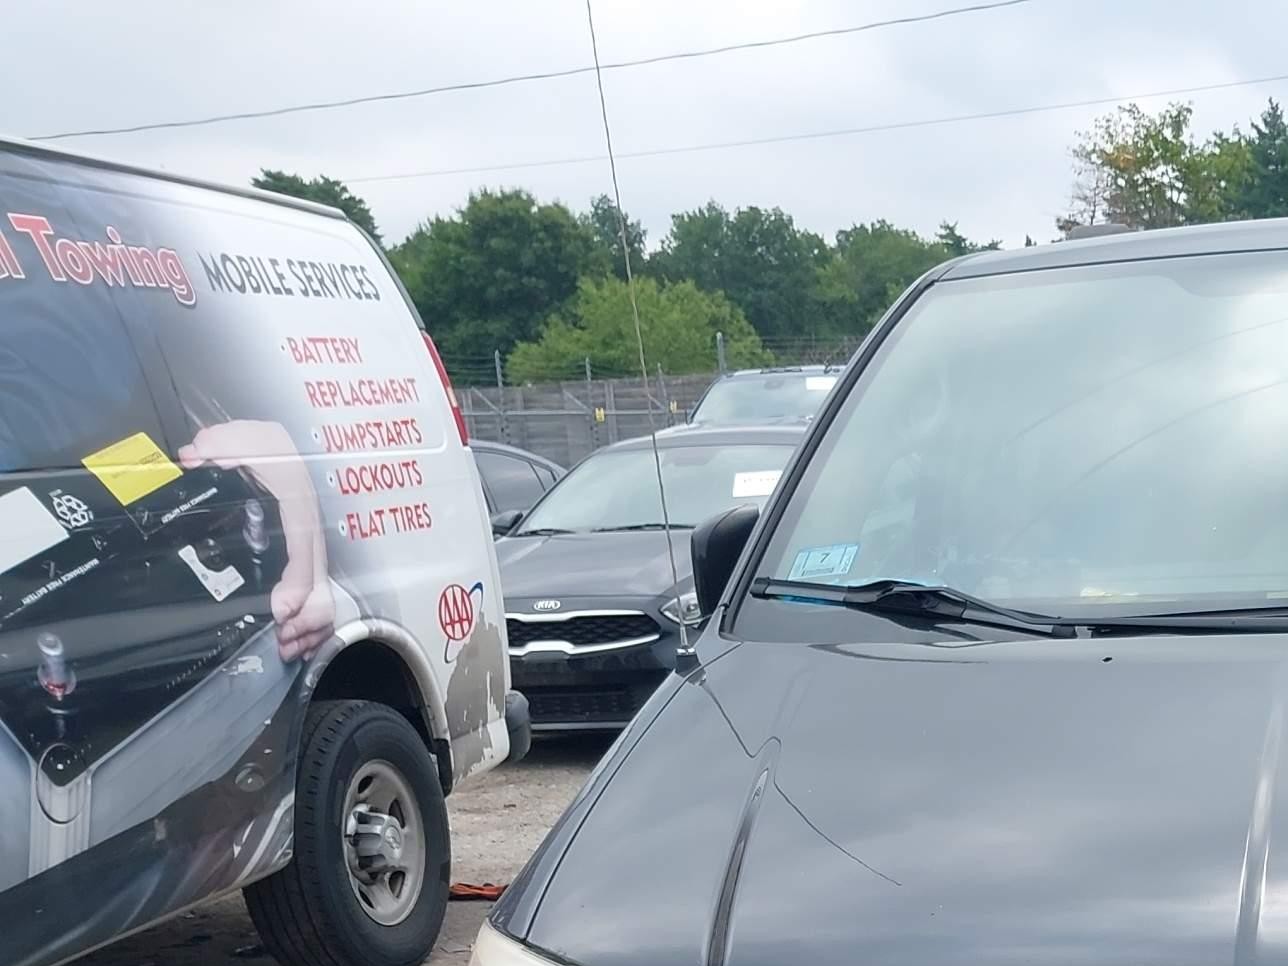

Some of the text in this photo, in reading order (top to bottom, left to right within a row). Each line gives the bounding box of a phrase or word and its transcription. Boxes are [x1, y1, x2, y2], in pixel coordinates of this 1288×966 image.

[7, 212, 196, 306] Towing
[197, 249, 381, 302] MOBILE SERVICES
[286, 336, 363, 365] BATTERY
[304, 378, 420, 408] REPLACEMENT
[322, 418, 423, 453] JUMPSTARTS
[335, 460, 423, 495] LOCKOUTS
[346, 502, 432, 541] FLAT TIRES
